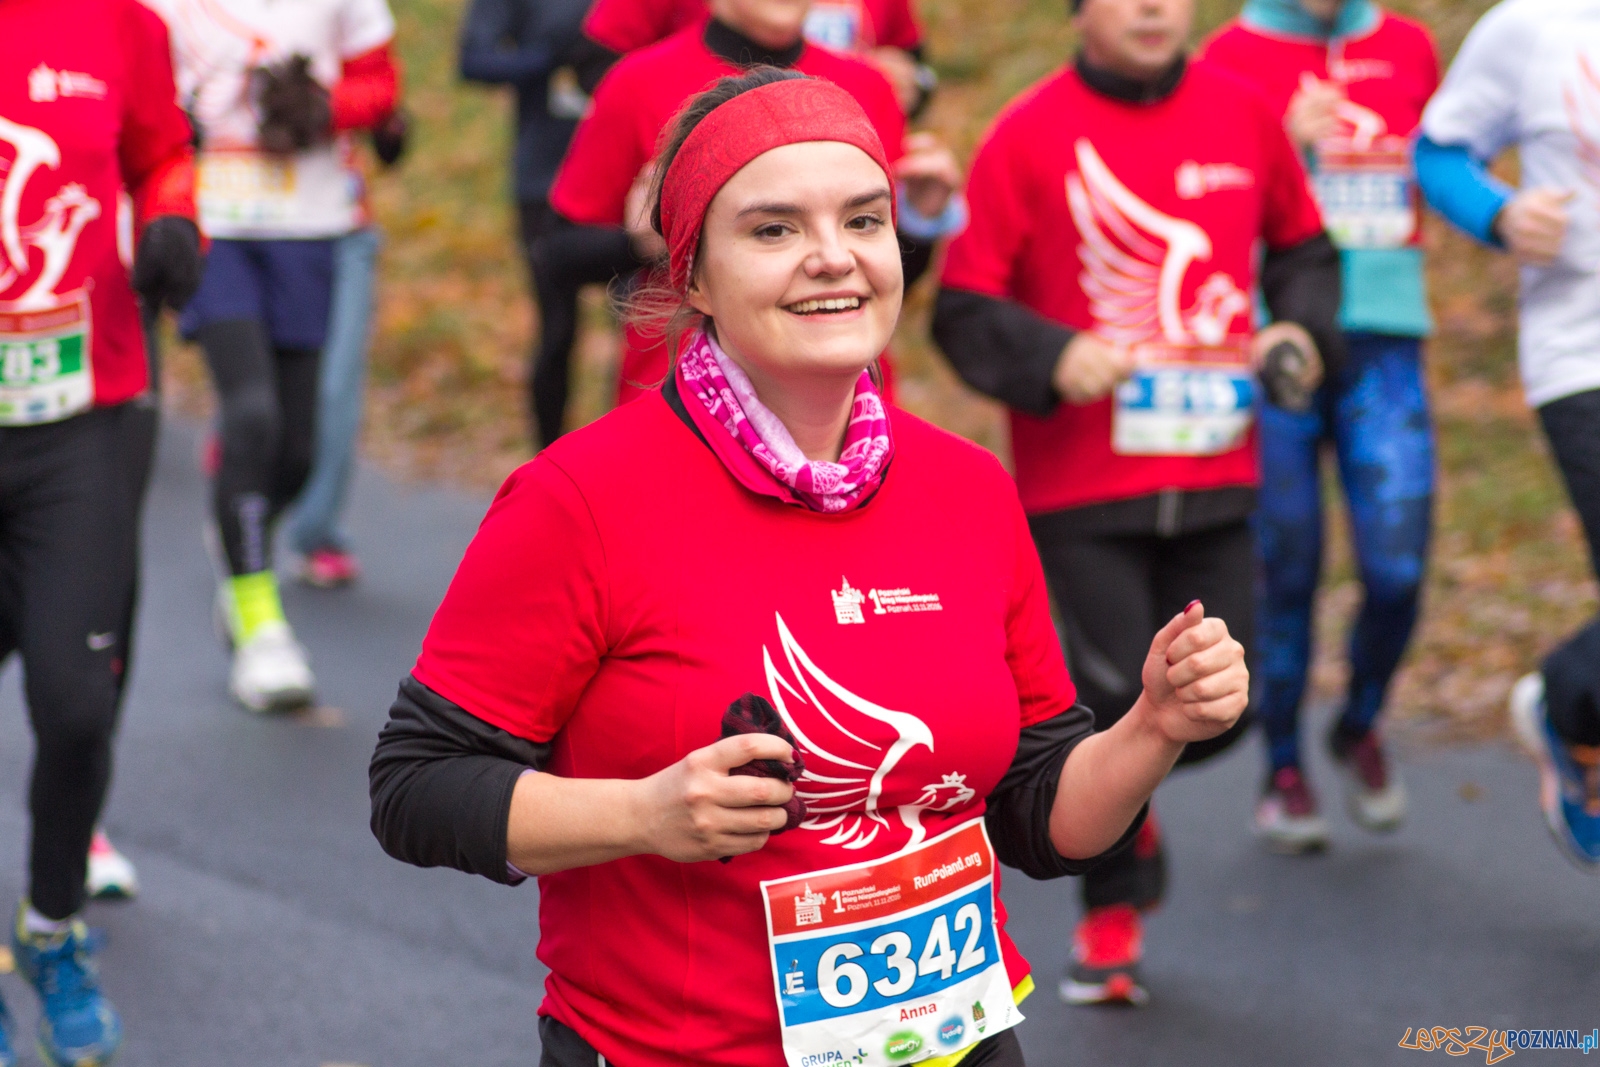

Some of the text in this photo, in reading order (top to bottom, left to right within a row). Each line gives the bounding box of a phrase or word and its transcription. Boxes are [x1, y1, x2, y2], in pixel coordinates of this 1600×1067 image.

[868, 588, 887, 614] 1
[913, 852, 982, 890] RunPoland.org
[831, 890, 846, 914] 1
[785, 902, 986, 1008] E 6342
[899, 1002, 938, 1022] Anna
[801, 1050, 843, 1067] GRUPA
